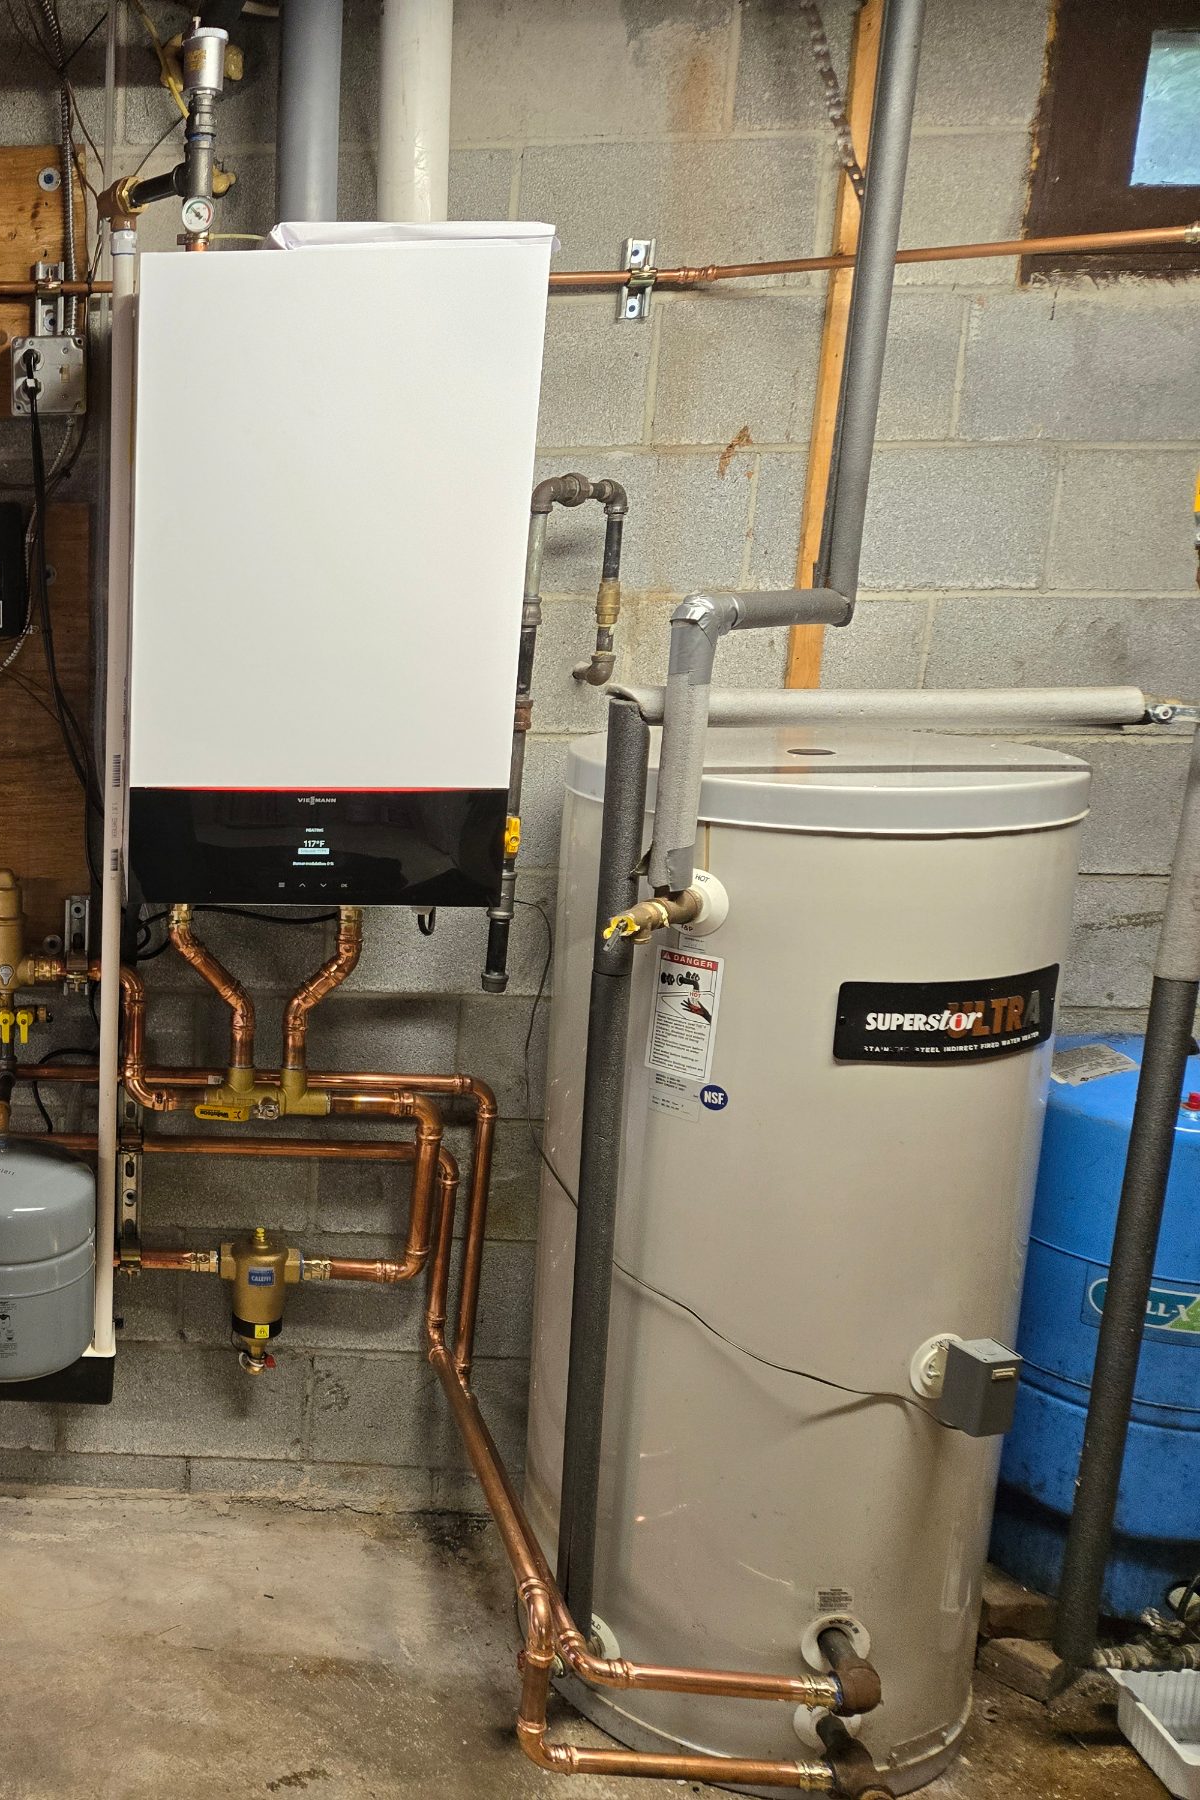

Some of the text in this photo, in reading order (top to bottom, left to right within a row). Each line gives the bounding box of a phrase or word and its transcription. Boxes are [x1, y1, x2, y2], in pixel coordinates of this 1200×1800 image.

[303, 840, 326, 848] 117°F
[695, 873, 710, 883] HOT
[673, 954, 714, 969] DANGER
[943, 1044, 978, 1053] INDIRECT
[980, 1041, 1000, 1050] FIRED
[1001, 1037, 1021, 1046] WATER
[1021, 1031, 1040, 1042] HEATER
[703, 1090, 725, 1105] NSF
